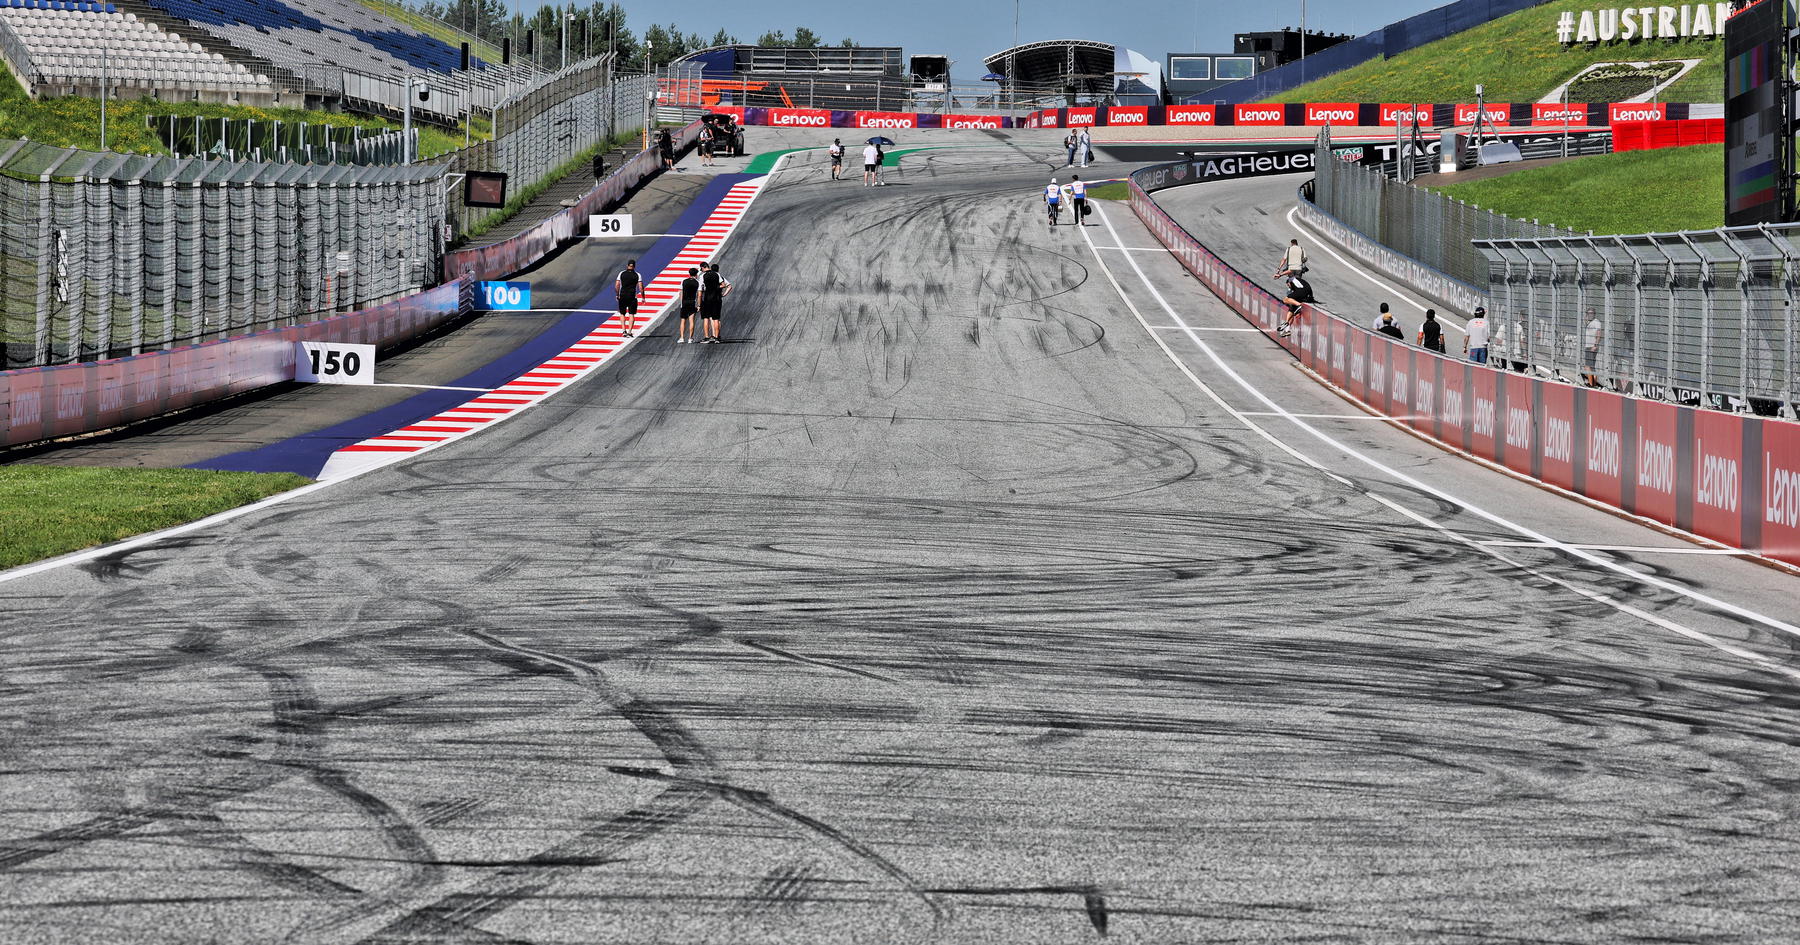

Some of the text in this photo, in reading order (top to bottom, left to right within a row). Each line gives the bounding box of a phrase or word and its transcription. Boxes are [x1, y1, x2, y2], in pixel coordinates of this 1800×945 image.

[1557, 3, 1732, 43] #AUSTRIAN
[773, 112, 826, 126] Lenovo
[859, 116, 912, 128] Lenovo
[1068, 112, 1093, 125] Lenovo
[1110, 111, 1144, 123] Lenovo
[1170, 110, 1211, 122] Lenovo
[1239, 109, 1281, 121] Lenovo
[1309, 108, 1355, 121] Lenovo
[1536, 108, 1583, 121] Lenovo
[1613, 108, 1661, 121] Lenovo
[946, 119, 997, 128] Lenovo
[601, 219, 621, 232] 50
[484, 287, 521, 305] 100
[310, 350, 361, 376] 150
[1416, 369, 1433, 416] Lenovo
[1443, 379, 1462, 428] Lenovo
[1473, 386, 1494, 438] Lenovo
[1507, 395, 1530, 450] Lenovo
[1545, 405, 1571, 463] Lenovo
[1589, 415, 1619, 478] Lenovo
[1639, 426, 1673, 494] Lenovo
[1697, 438, 1738, 513] Lenovo
